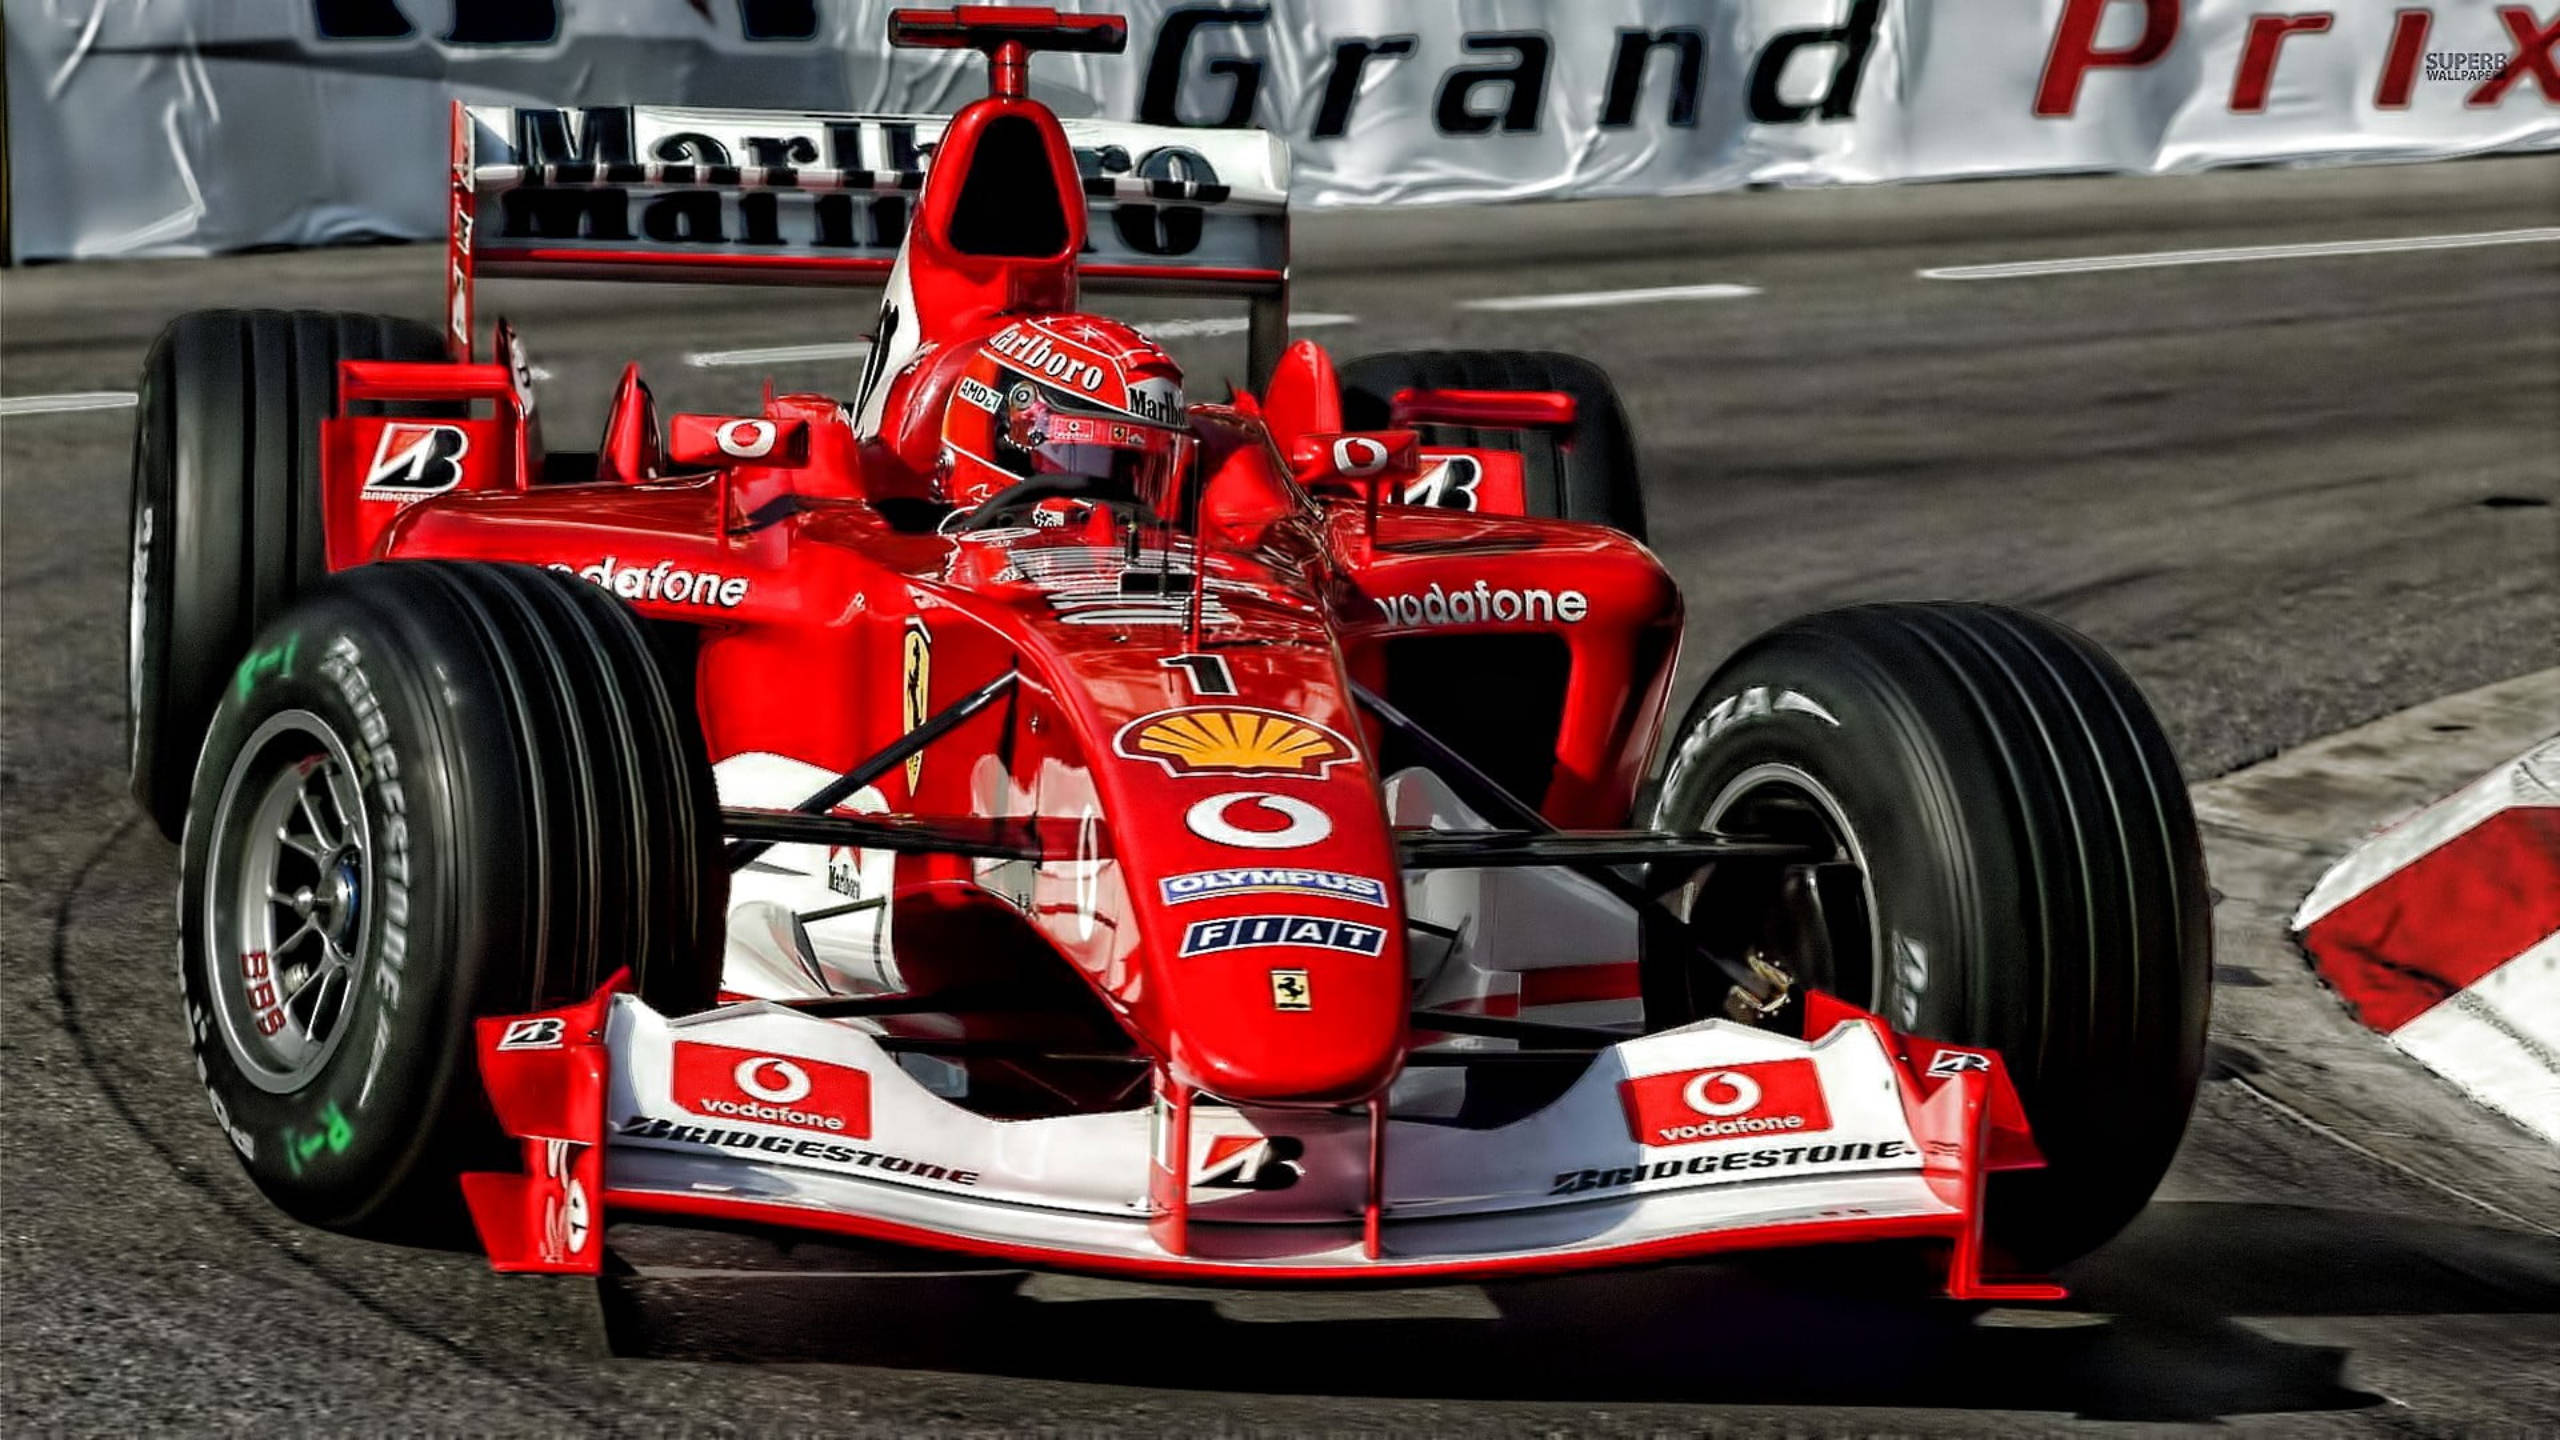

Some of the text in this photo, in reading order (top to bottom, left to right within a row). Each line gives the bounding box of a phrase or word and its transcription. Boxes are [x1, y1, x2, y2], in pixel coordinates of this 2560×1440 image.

[1135, 0, 2560, 141] Grand Prix
[961, 380, 988, 404] AMD
[546, 555, 749, 608] dafone
[1374, 580, 1588, 627] vodafone
[1157, 653, 1239, 697] 1
[1169, 870, 1380, 898] OLYMPUS
[1197, 918, 1377, 950] FIAT
[241, 951, 287, 1038] BBS
[701, 1098, 846, 1131] vodafone
[1659, 1115, 1805, 1141] vodafone
[617, 1115, 981, 1187] BRIDGESTONE
[1546, 1140, 1907, 1197] BRIDGESTONE
